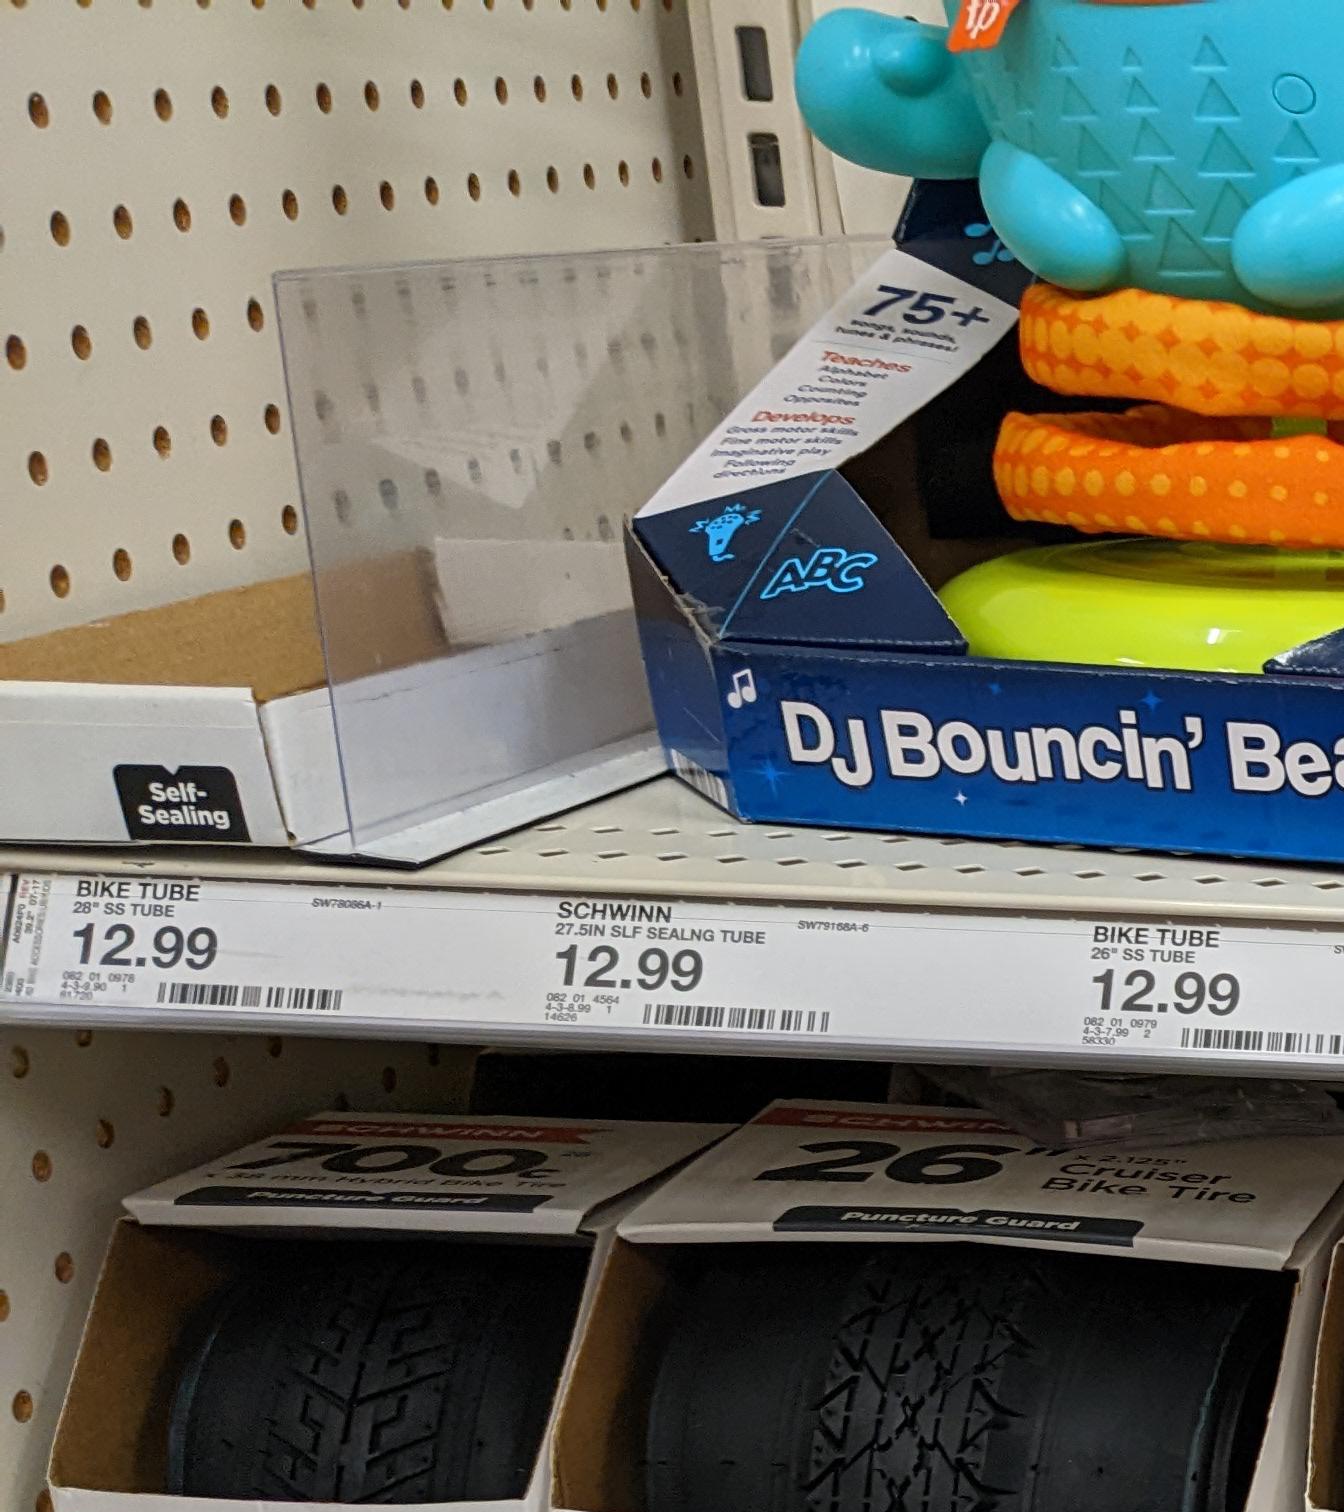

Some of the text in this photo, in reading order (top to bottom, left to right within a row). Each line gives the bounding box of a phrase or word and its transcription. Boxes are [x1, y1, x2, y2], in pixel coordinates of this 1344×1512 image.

[863, 284, 990, 327] 75+
[760, 548, 879, 602] ABC
[149, 782, 208, 803] Self-
[137, 804, 231, 830] Sealing
[76, 880, 201, 902] BIKE TUBE
[557, 901, 672, 924] SCHWINN
[73, 922, 218, 971] 12.99
[555, 923, 766, 945] 27.5IN SLF SEALNG TUBE
[1093, 925, 1220, 948] BIKE TUBE
[555, 943, 703, 992] 12.99
[1091, 968, 1241, 1017] 12.99
